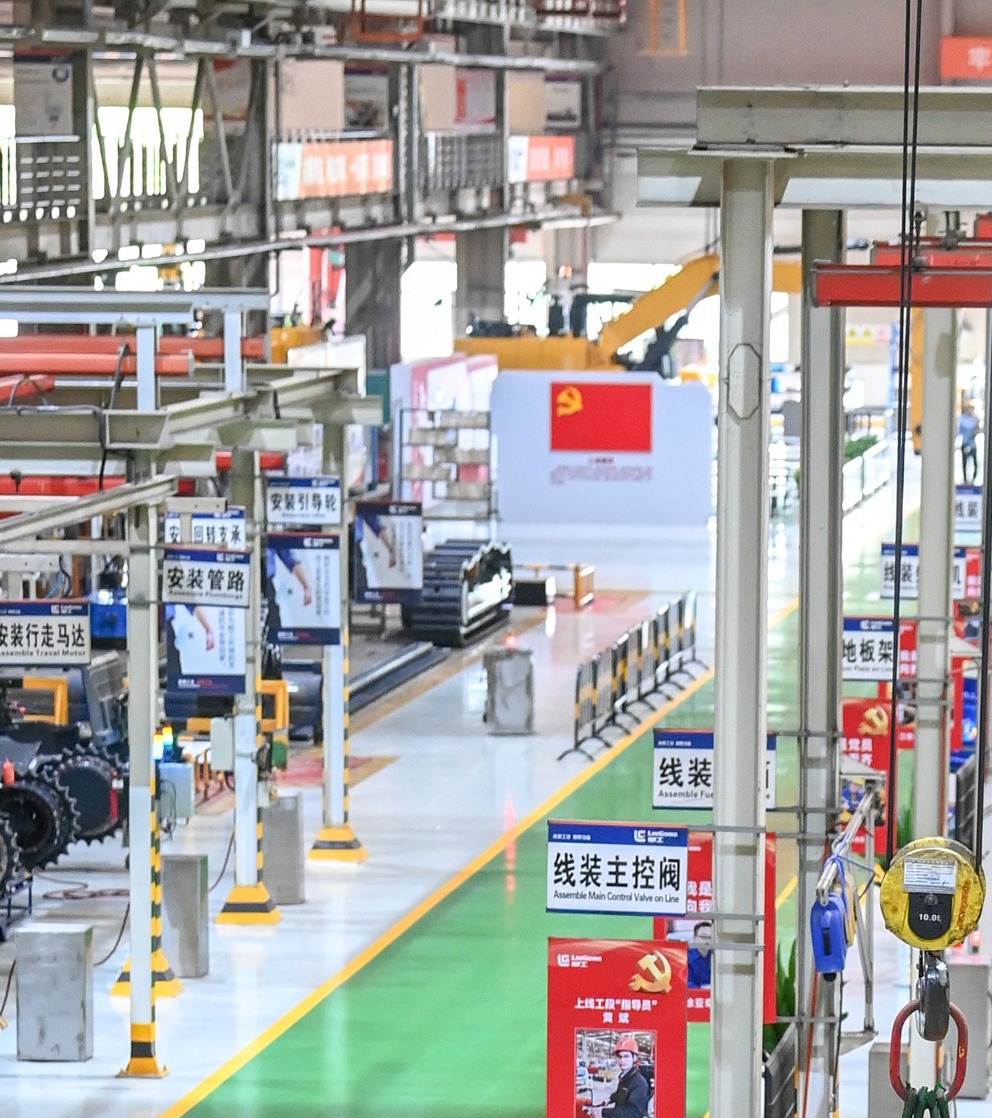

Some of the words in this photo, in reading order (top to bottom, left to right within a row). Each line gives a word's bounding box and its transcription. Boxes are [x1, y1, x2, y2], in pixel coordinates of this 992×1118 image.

[168, 524, 242, 545] 安回转支承
[168, 566, 245, 592] 安装管路
[0, 622, 85, 648] 安装行走马达
[658, 790, 698, 799] Assemble
[700, 790, 714, 799] Fue
[553, 852, 680, 891] 线装主控阀
[553, 890, 587, 900] Assemble
[588, 891, 606, 900] Main
[607, 892, 633, 902] Control
[634, 893, 653, 902] Valve
[665, 894, 680, 903] Line
